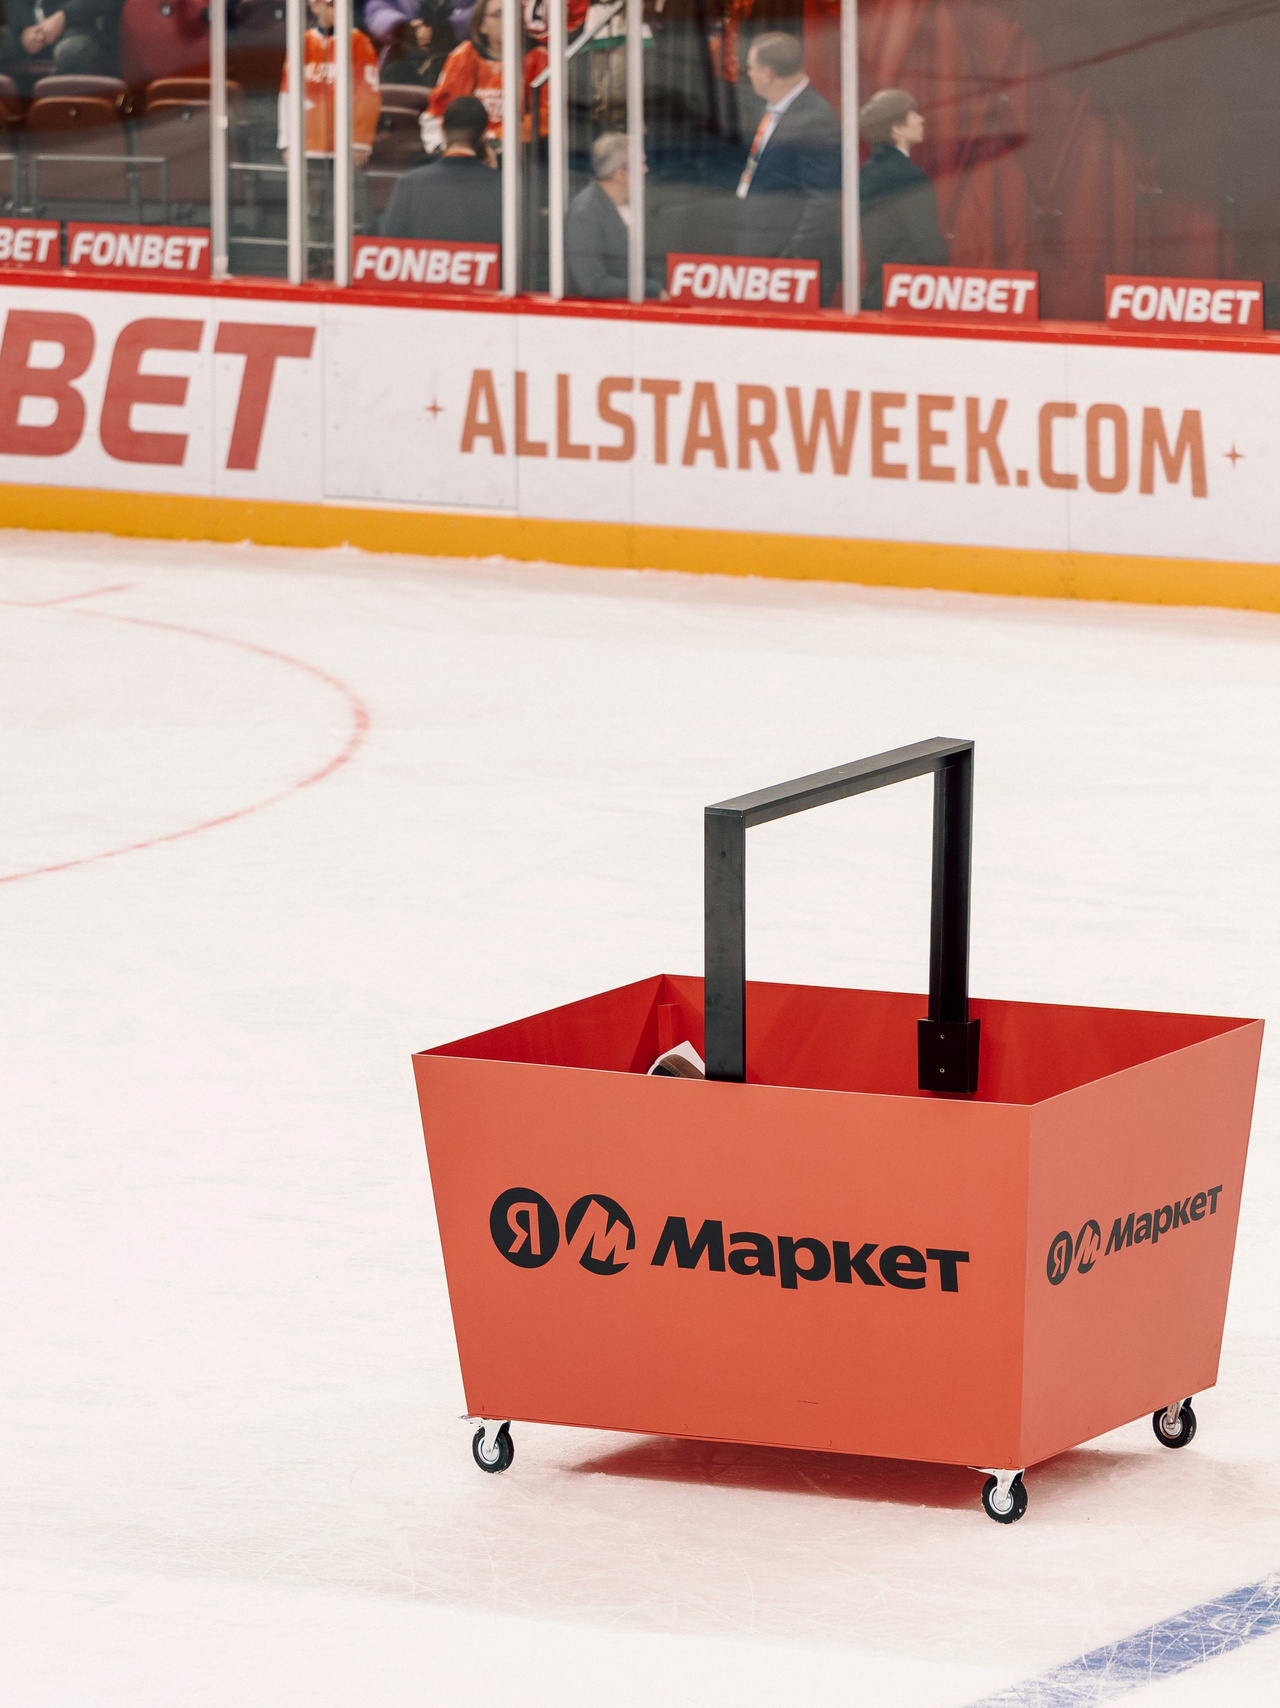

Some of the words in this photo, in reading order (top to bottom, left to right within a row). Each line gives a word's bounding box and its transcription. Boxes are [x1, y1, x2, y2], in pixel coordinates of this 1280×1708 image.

[70, 231, 208, 270] FONBET
[356, 245, 497, 286] FONBET
[670, 263, 815, 304] FONBET
[887, 274, 1035, 314] FONBET
[1109, 285, 1260, 325] FONBET
[460, 369, 1208, 499] ALLSTARWEEK.COM
[1104, 1184, 1223, 1257] Маркет
[650, 1215, 970, 1293] Маркет
